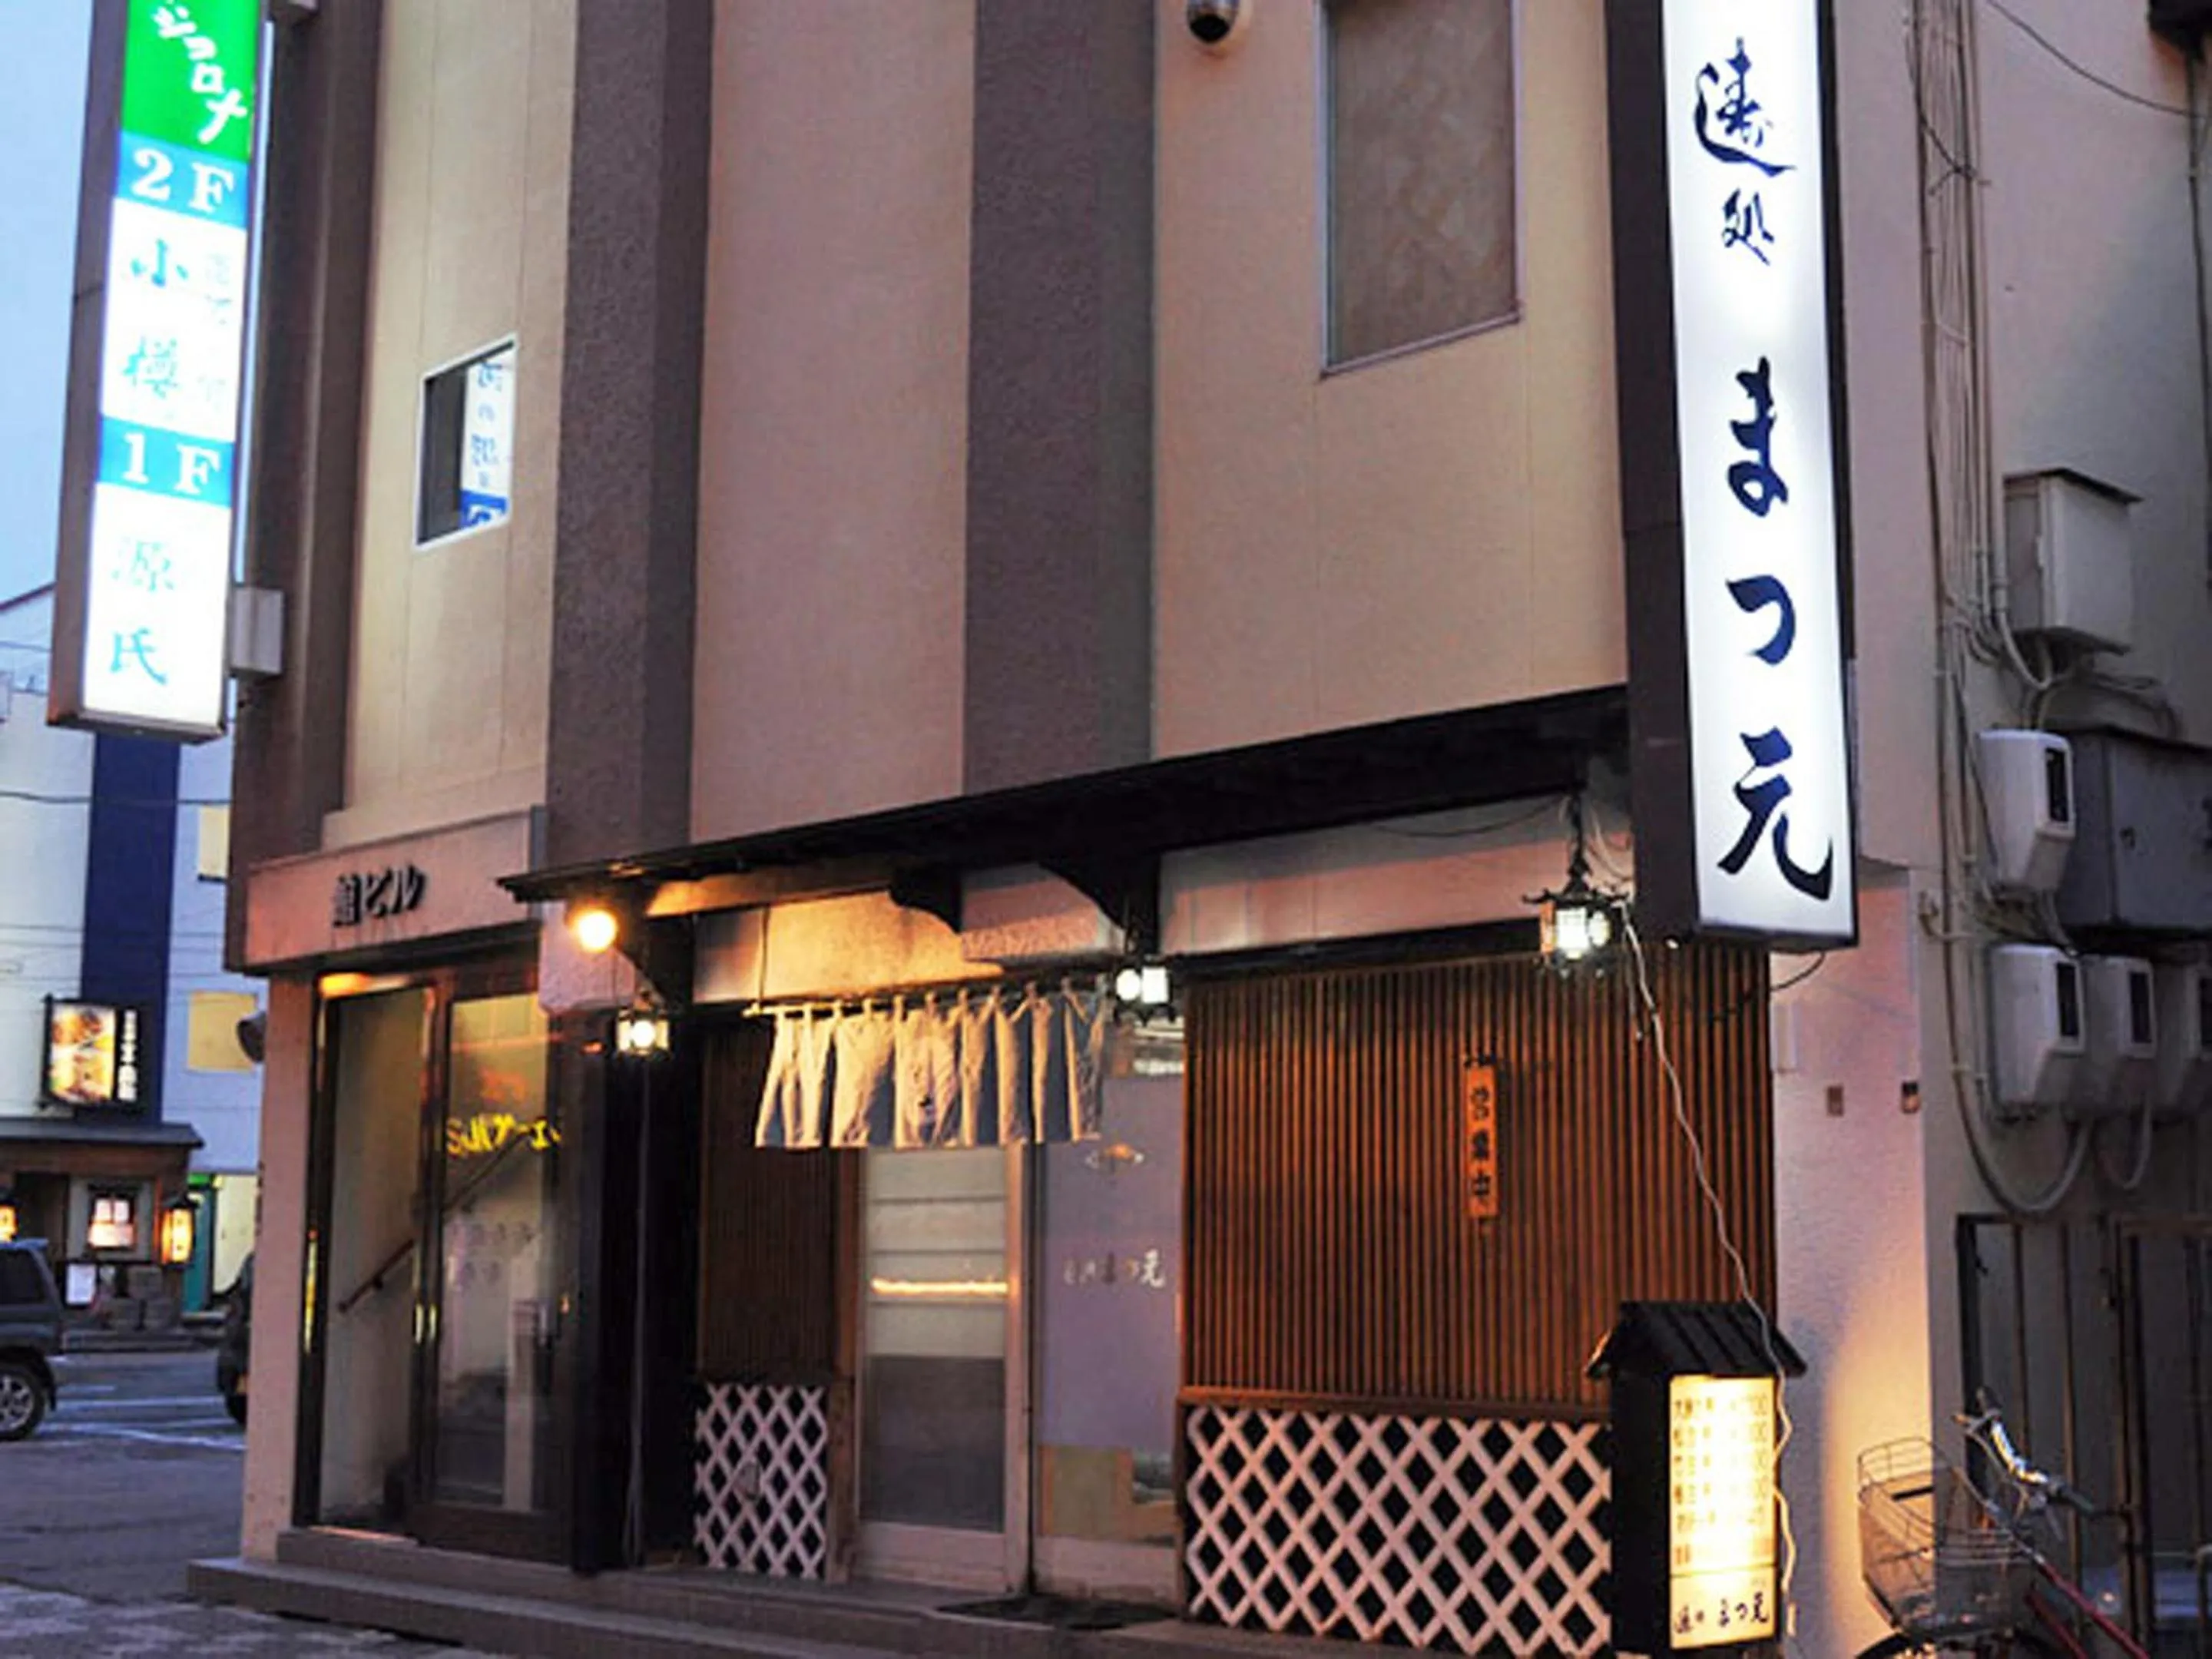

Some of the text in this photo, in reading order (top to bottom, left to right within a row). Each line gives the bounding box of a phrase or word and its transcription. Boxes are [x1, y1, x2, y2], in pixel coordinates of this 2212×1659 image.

[131, 149, 234, 214] 2F
[122, 432, 220, 495] 1F
[1717, 356, 1833, 900] まつ元
